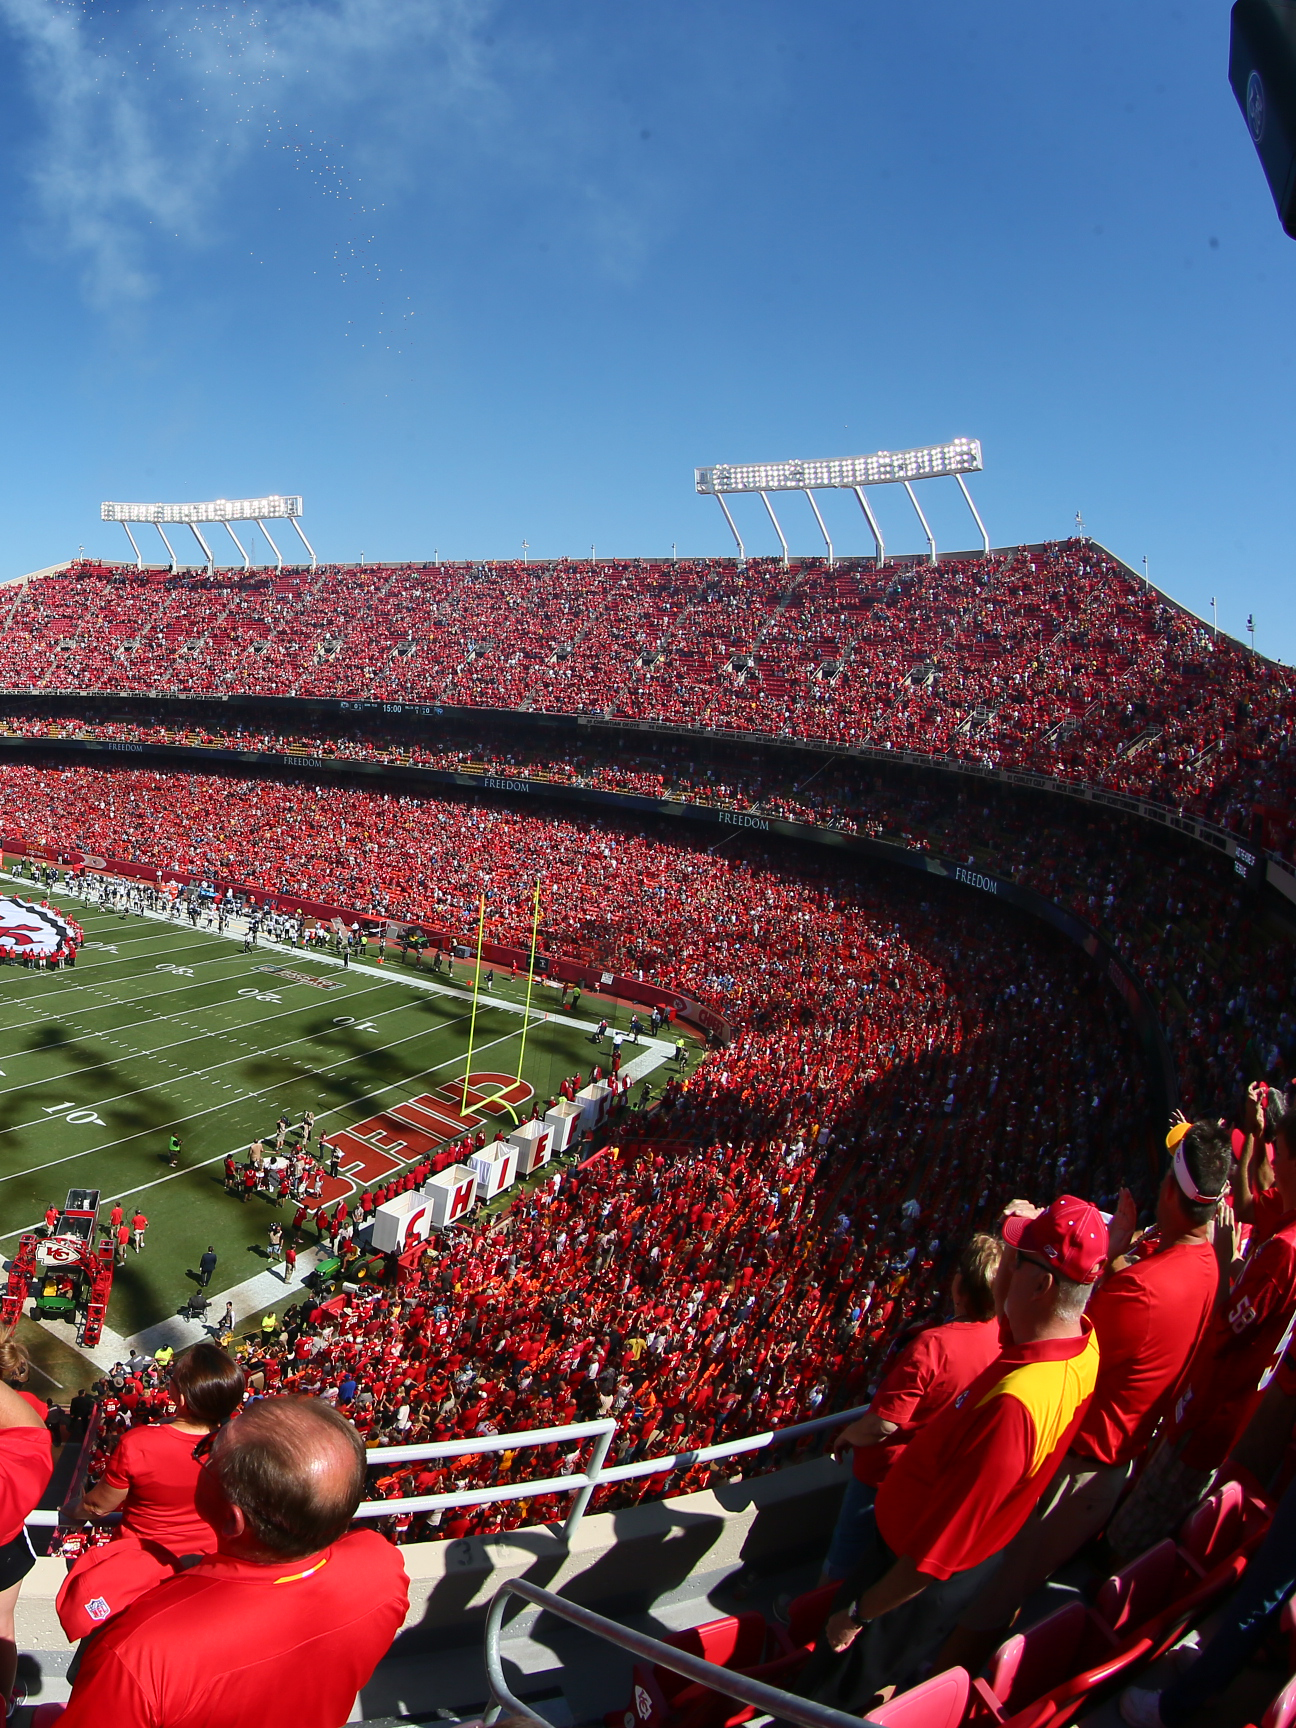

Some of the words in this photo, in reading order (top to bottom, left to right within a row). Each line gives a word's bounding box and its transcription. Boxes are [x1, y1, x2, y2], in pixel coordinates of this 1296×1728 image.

[383, 704, 402, 713] 15:00
[108, 743, 142, 752] FREEDOM
[858, 747, 873, 756] JACK
[874, 749, 904, 761] STEADMAN
[283, 757, 322, 768] FREEDOM
[933, 760, 949, 770] SMITH
[964, 766, 984, 774] ALBERT
[985, 770, 1000, 778] LEWIS
[484, 778, 529, 792] FREEDOM
[1013, 775, 1032, 784] CURLEY
[1033, 778, 1045, 787] CULP
[718, 812, 769, 830] FREEDOM
[955, 867, 997, 894] FREEDOM
[156, 964, 194, 977] 30
[238, 988, 282, 1004] 20
[333, 1017, 379, 1033] 10
[42, 1102, 106, 1126] 10
[46, 1247, 70, 1261] KC
[1228, 1294, 1256, 1334] 58
[92, 1604, 108, 1618] NFL
